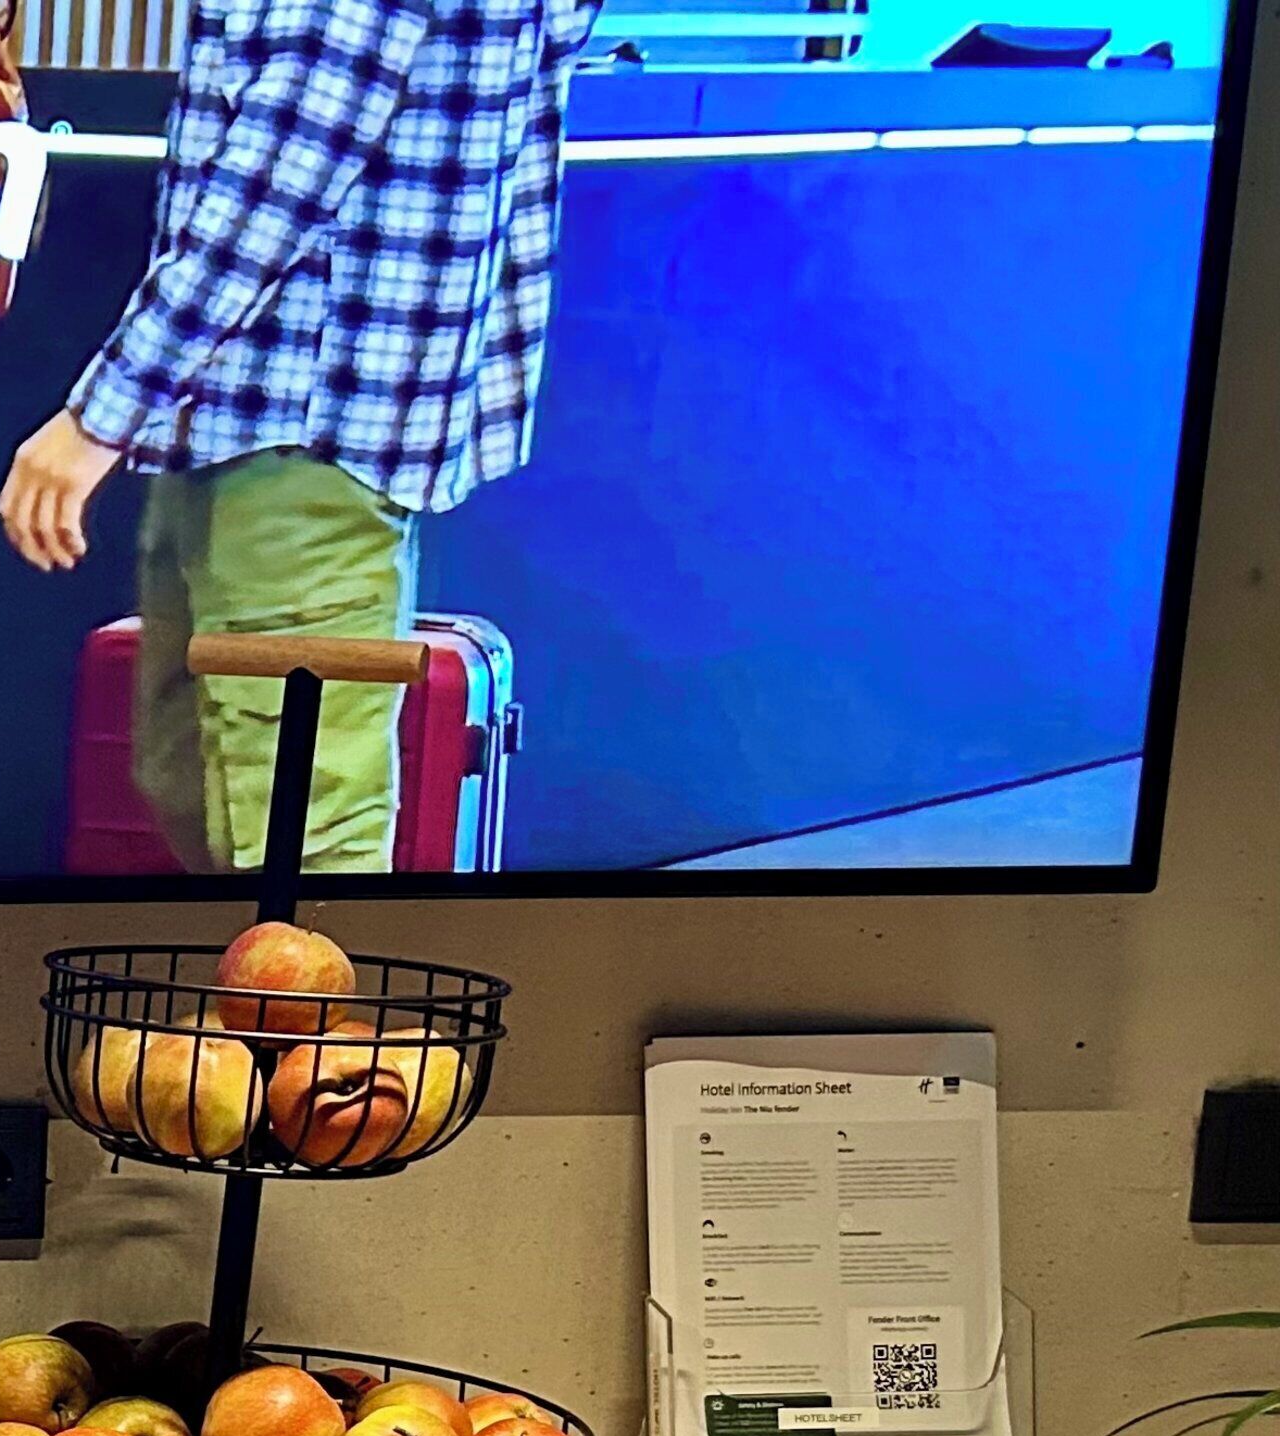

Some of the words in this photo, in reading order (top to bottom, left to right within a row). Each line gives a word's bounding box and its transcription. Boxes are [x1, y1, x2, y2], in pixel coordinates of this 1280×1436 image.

[700, 1083, 734, 1096] Hotel
[738, 1081, 811, 1096] Information
[815, 1081, 852, 1095] Sheet
